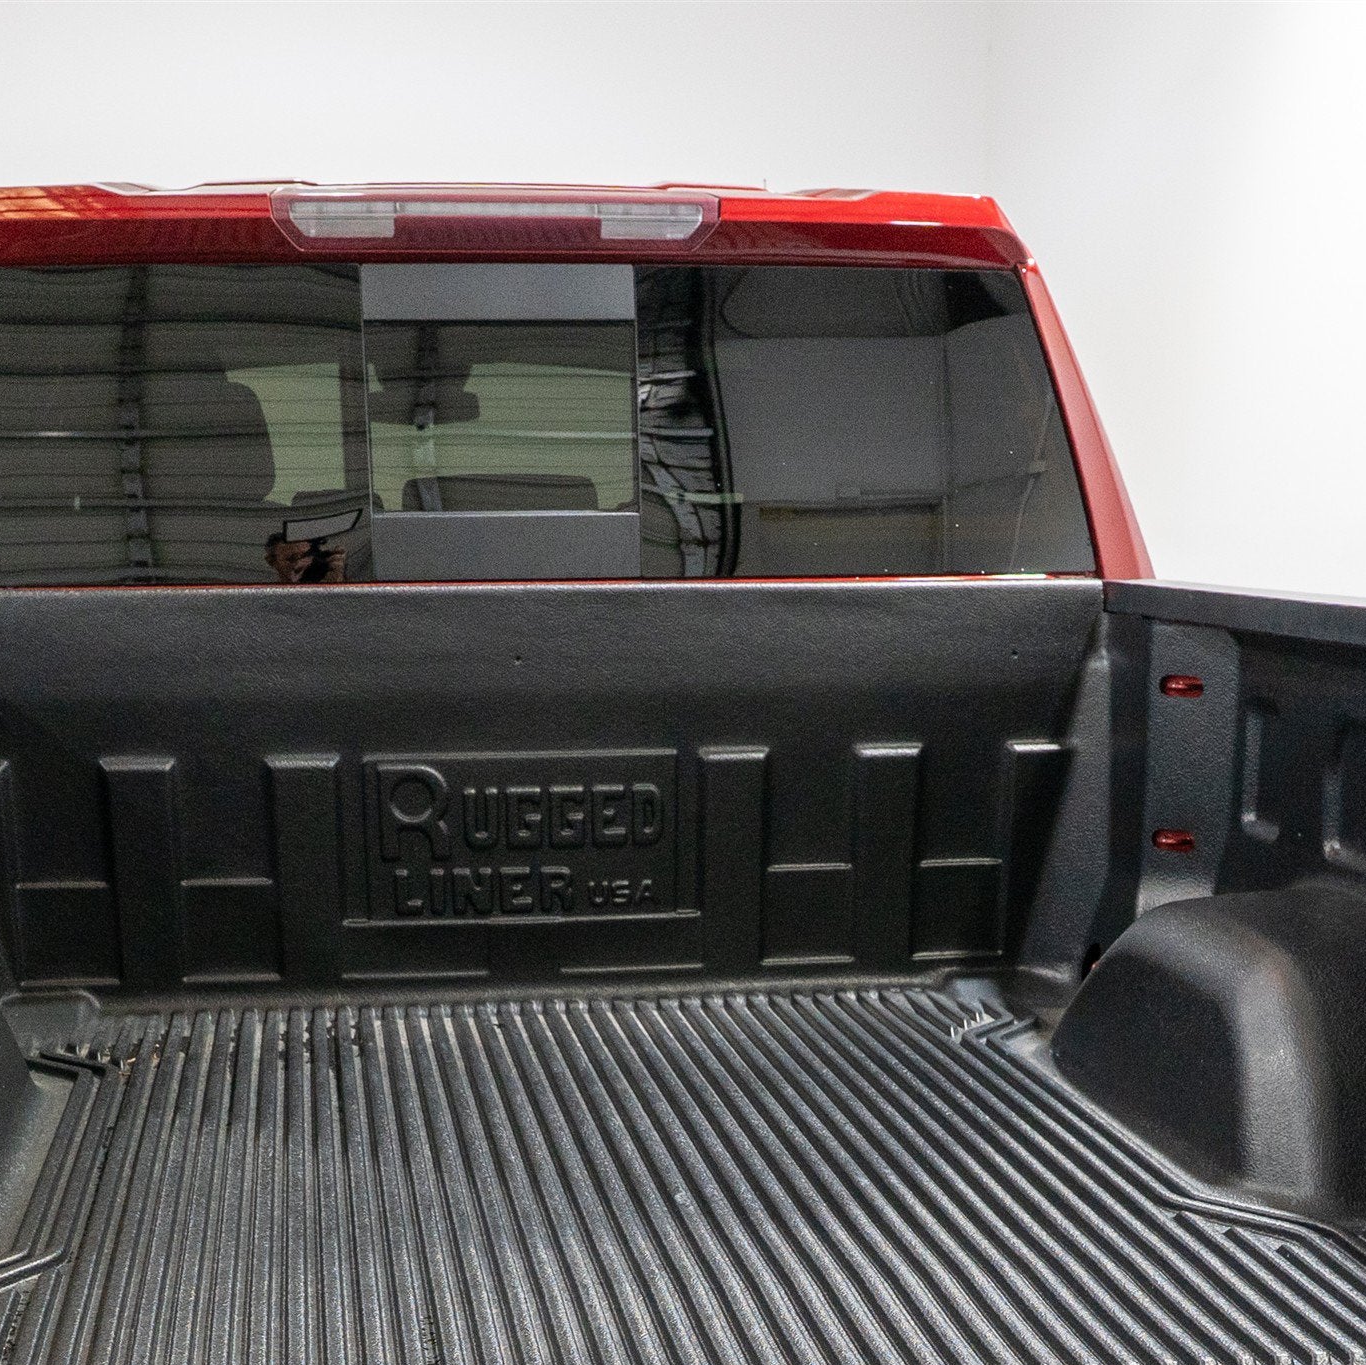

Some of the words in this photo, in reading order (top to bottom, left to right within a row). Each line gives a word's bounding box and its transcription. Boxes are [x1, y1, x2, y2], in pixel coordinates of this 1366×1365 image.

[377, 764, 663, 862] RUGGED
[395, 866, 572, 916] LINER
[588, 879, 653, 905] USA
